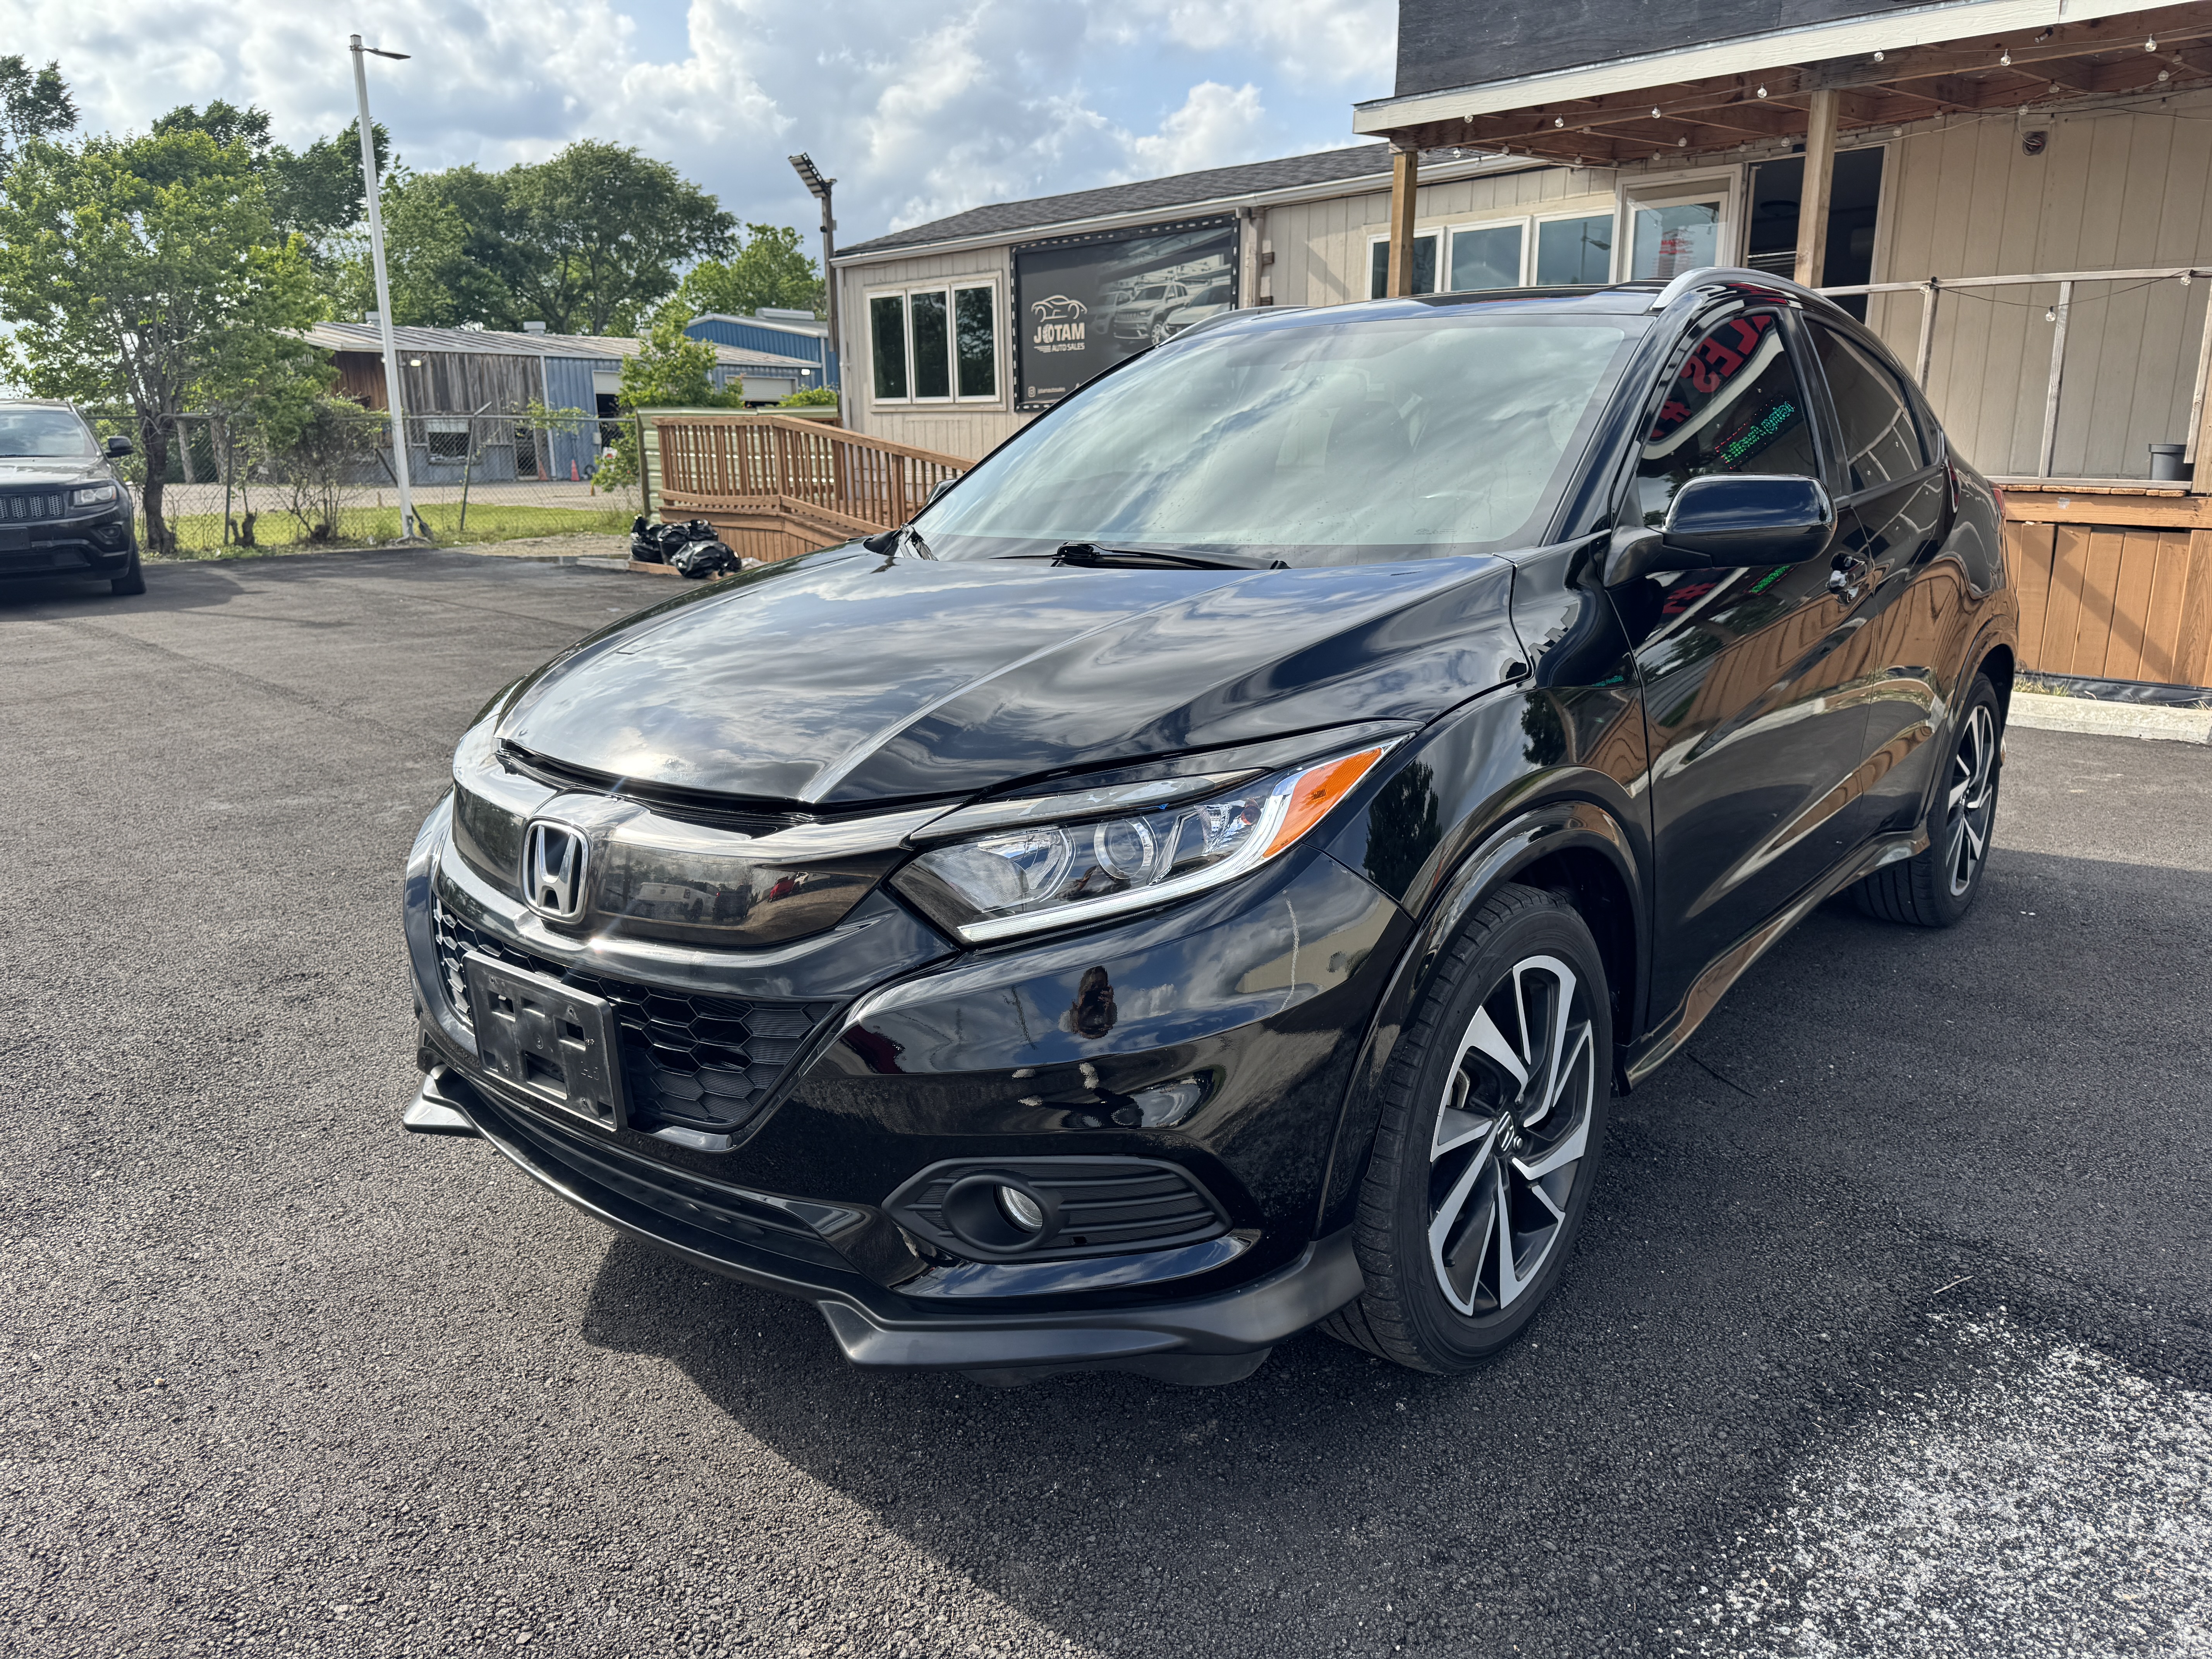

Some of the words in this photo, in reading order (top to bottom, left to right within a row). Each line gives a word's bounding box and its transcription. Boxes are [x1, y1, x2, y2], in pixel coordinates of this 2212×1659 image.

[1033, 322, 1085, 343] JOTAM
[1051, 343, 1067, 352] AUTO
[1067, 342, 1085, 351] SALES
